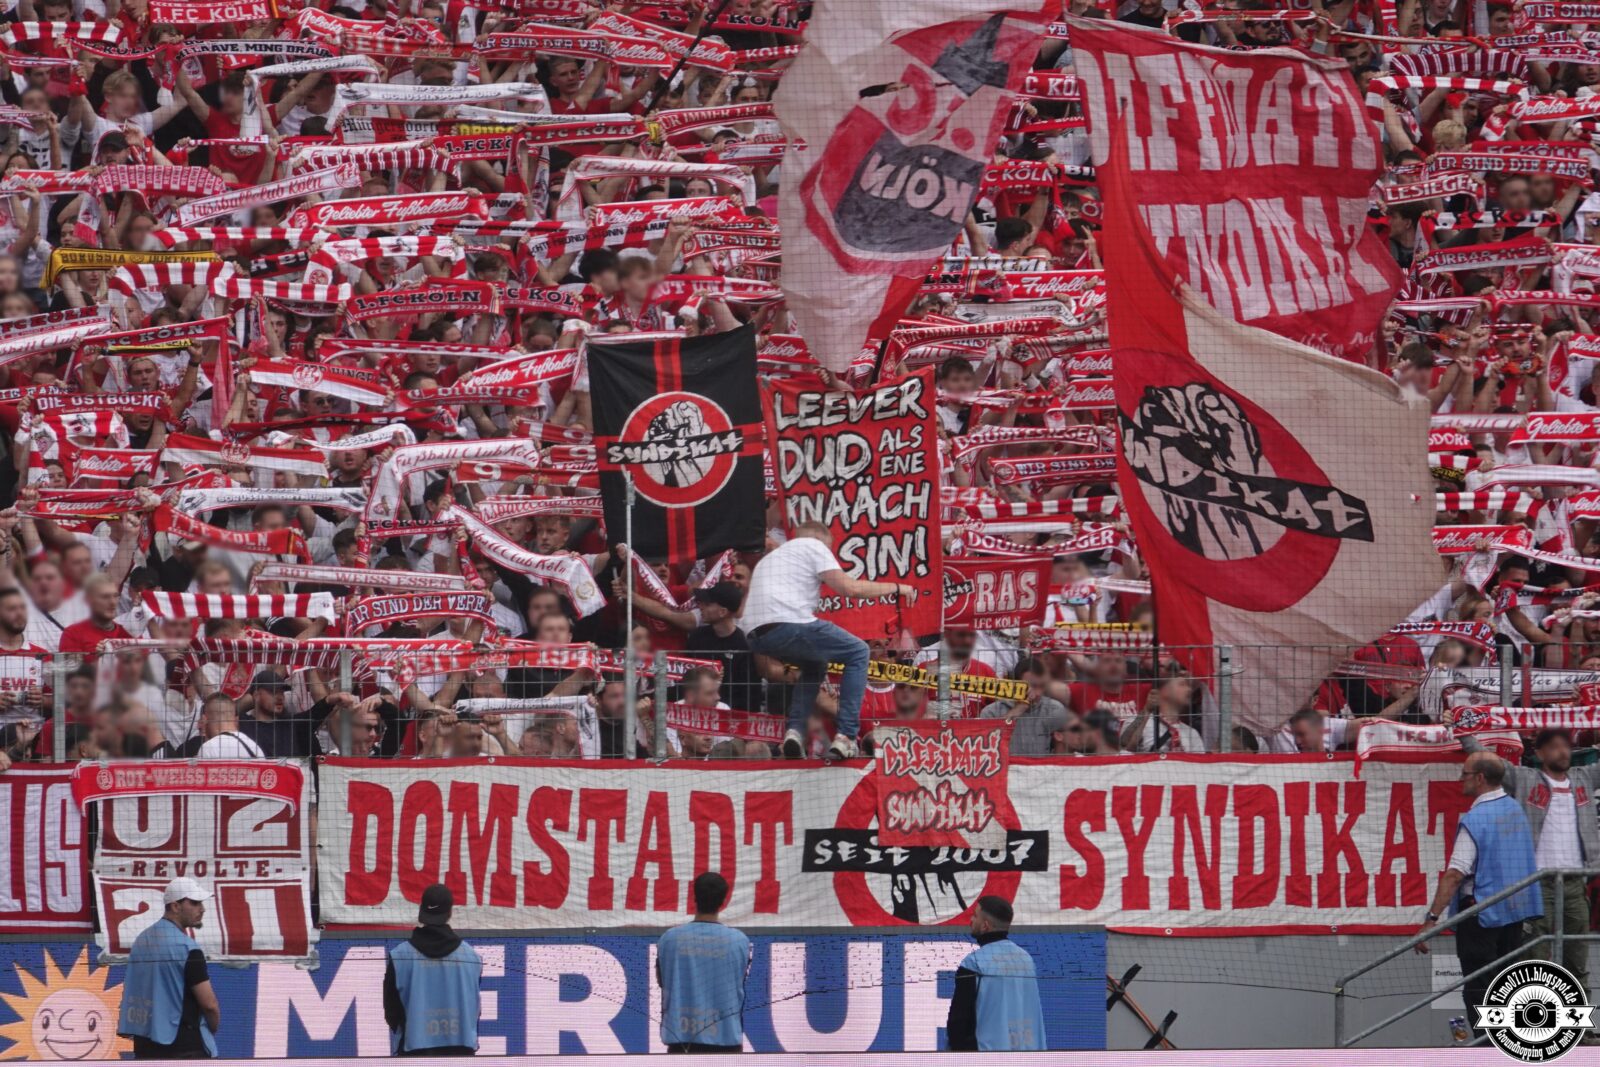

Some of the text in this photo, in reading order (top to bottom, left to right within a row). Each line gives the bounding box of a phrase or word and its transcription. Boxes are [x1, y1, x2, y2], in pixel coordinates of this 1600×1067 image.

[210, 3, 267, 19] KÖLN
[1524, 4, 1554, 17] WIR
[245, 43, 282, 53] MING
[1511, 99, 1572, 119] Geliebter
[576, 122, 637, 137] KÖLN
[1002, 166, 1053, 181] KÖLN
[1462, 157, 1505, 171] SIND
[1509, 158, 1540, 172] DIE
[1545, 160, 1587, 178] FANS
[288, 176, 324, 195] Köln
[317, 193, 469, 224] Geliebter Fußballclub
[1492, 210, 1557, 223] KÖLN
[60, 251, 126, 265] BORUSSIA
[412, 290, 481, 306] KÖLN
[30, 305, 98, 327] KÖLN
[140, 324, 205, 342] KÖLN
[36, 396, 65, 411] DIE
[774, 376, 928, 430] LEEVER
[1528, 416, 1588, 438] Geliebter
[395, 444, 539, 468] Fußball Club Köln
[777, 424, 923, 489] DUD ALS
[879, 452, 926, 477] ENE
[1015, 462, 1046, 475] WIR
[1050, 460, 1090, 471] SIND
[838, 526, 929, 581] SIN!
[536, 557, 567, 575] Köln
[336, 572, 392, 587] WEISS
[397, 575, 451, 589] ESSEN
[975, 572, 1038, 613] RAS
[372, 596, 408, 616] SIND
[412, 594, 442, 612] DER
[914, 666, 1028, 701] DOTMUND
[113, 767, 260, 788] ROT-WEISS ESSEN
[344, 780, 795, 914] DOMSTADT
[1059, 778, 1473, 911] SYNDIKAT
[131, 859, 270, 878] REVOLTE
